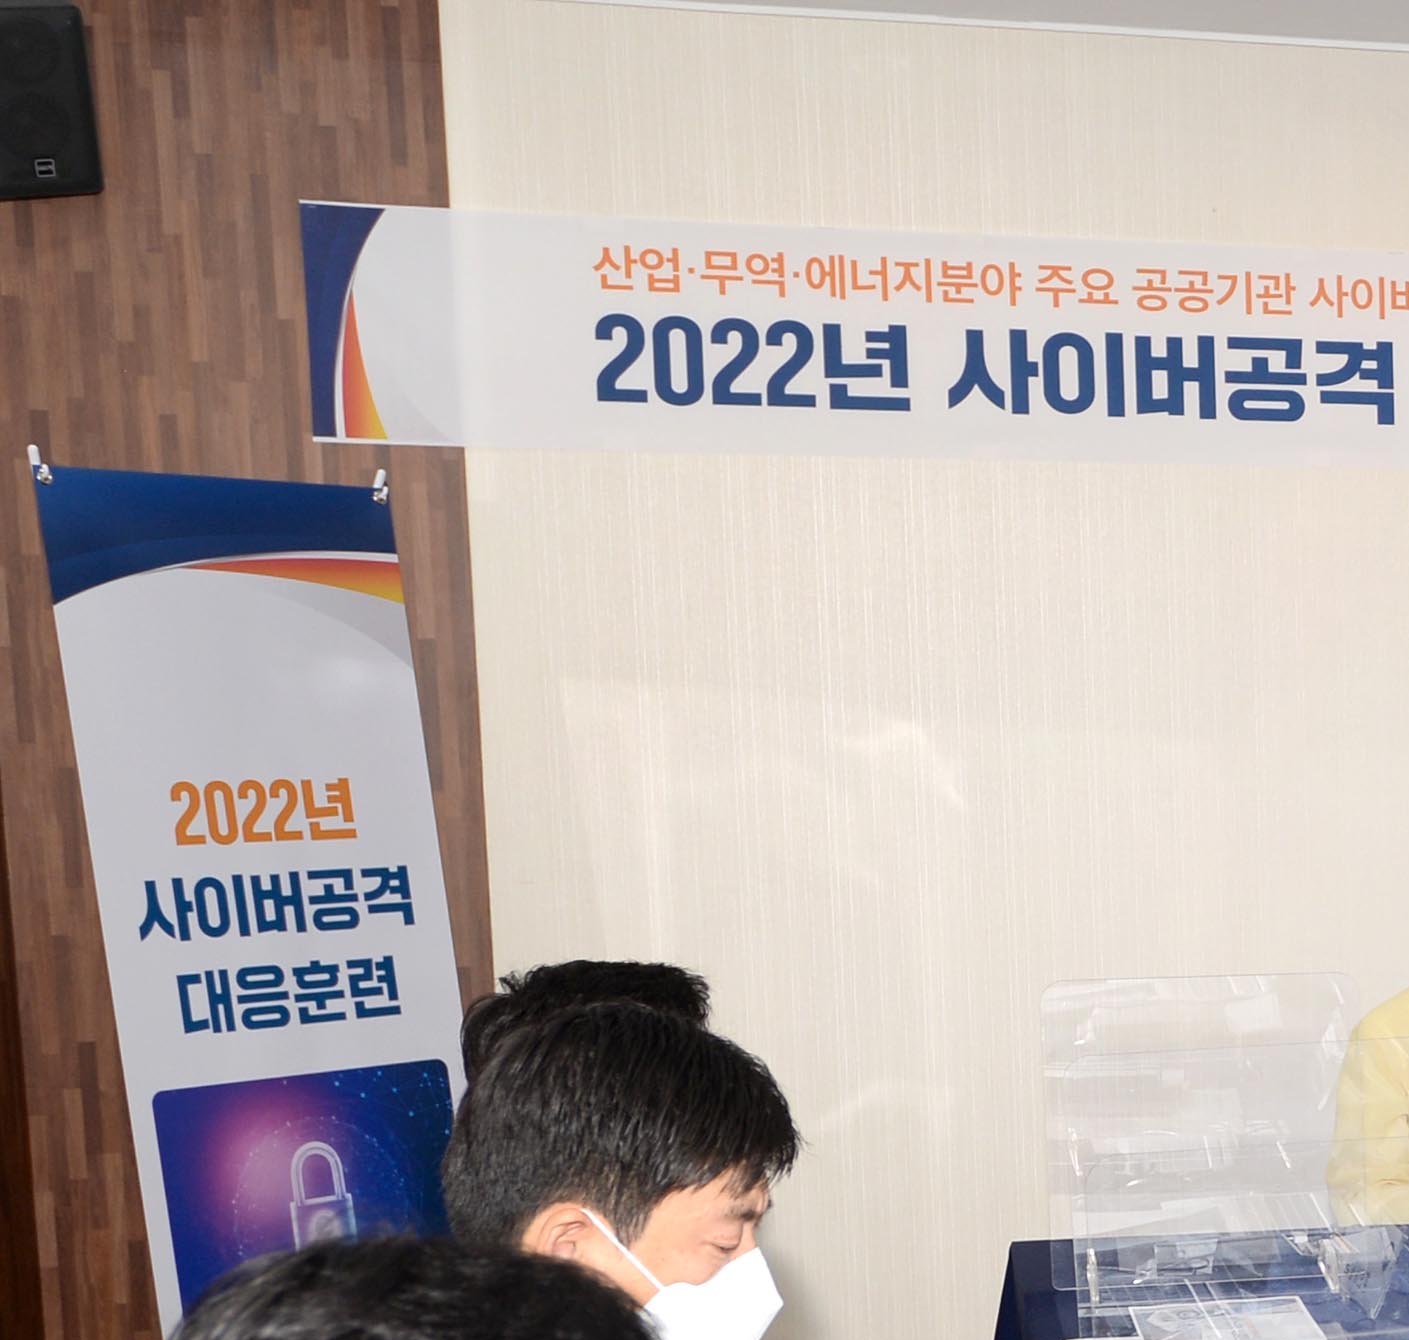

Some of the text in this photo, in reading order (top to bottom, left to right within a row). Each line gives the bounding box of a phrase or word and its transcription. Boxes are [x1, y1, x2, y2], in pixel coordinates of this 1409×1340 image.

[594, 245, 1023, 308] 산업·무역·에너지분야
[1035, 264, 1119, 309] 주요
[1133, 267, 1297, 317] 공공기관
[593, 313, 910, 410] 2022년
[948, 329, 1394, 424] 사이버공격
[171, 778, 358, 846] 2022년
[138, 864, 416, 942] 사이버공격
[176, 954, 402, 1034] 대응훈련
